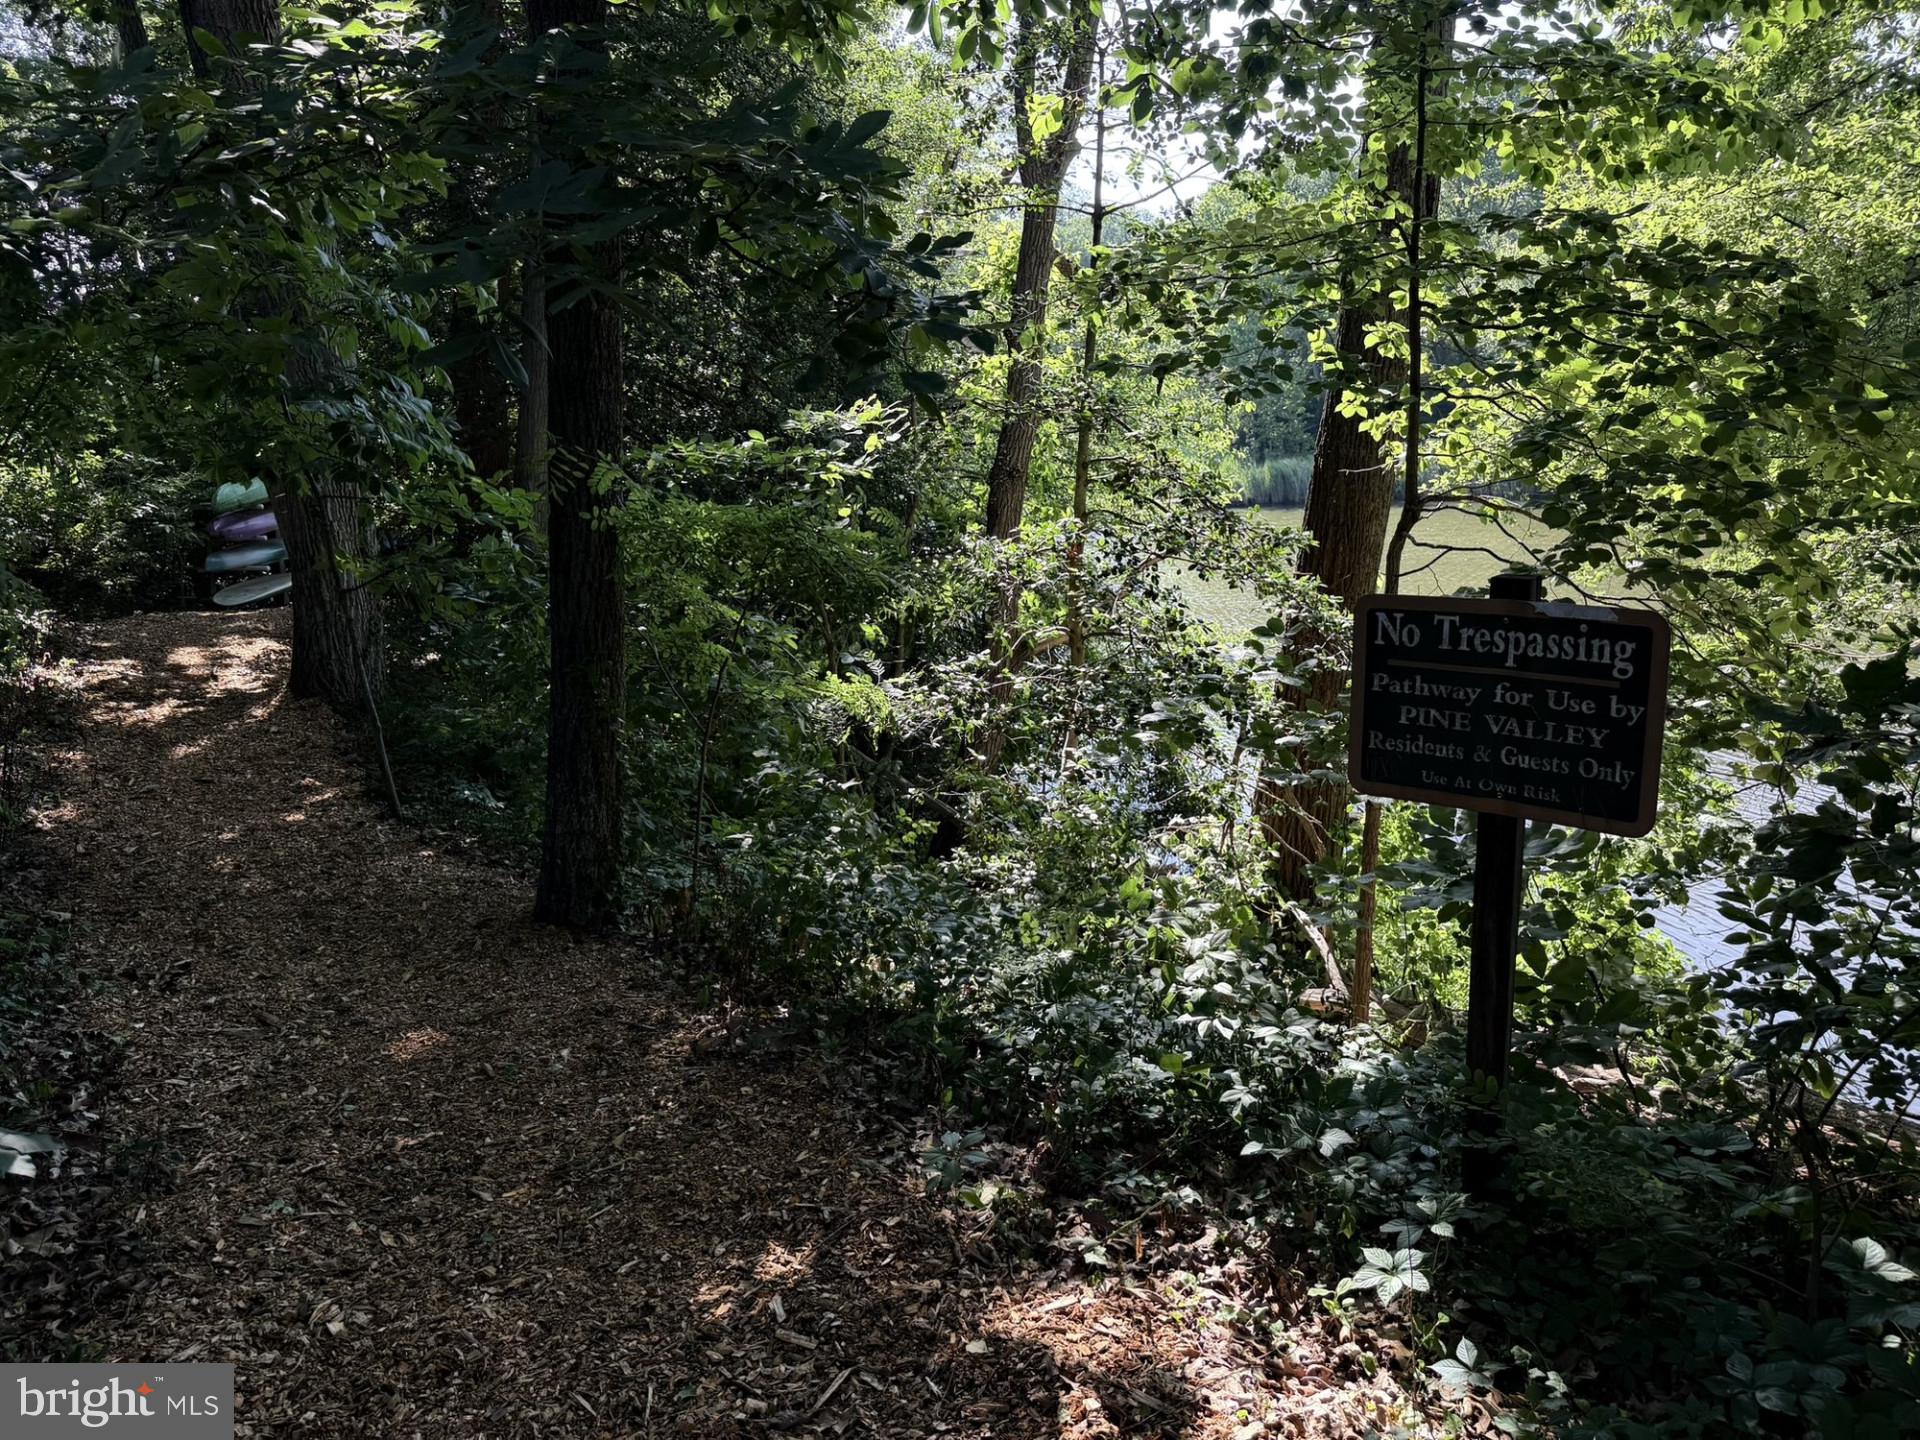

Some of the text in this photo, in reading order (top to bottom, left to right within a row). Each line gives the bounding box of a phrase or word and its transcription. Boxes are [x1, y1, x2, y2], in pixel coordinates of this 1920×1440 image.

[1374, 611, 1636, 679] No Trespassing
[1371, 673, 1645, 725] Pathway for Use by
[1399, 705, 1611, 748] PINE VALLEY
[1368, 730, 1636, 790] Residents & Guests Only
[1422, 771, 1561, 802] Use At Own Risk
